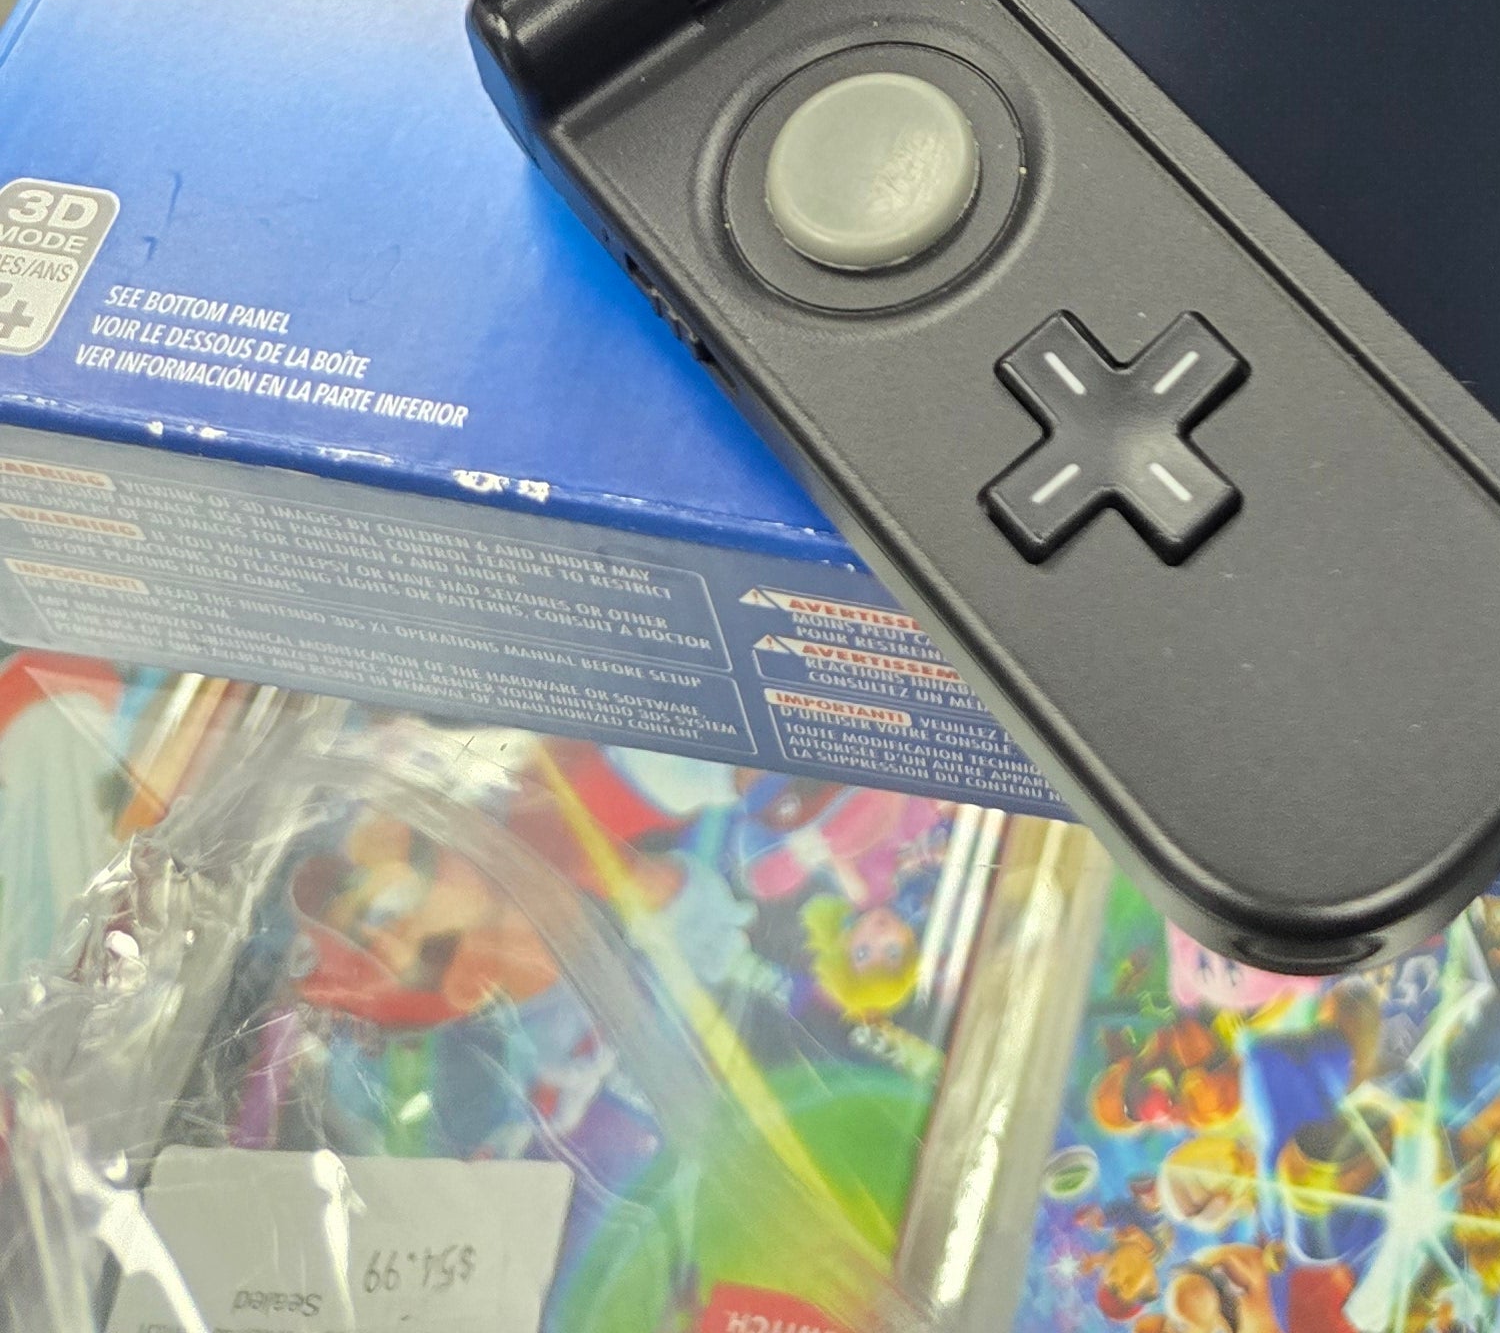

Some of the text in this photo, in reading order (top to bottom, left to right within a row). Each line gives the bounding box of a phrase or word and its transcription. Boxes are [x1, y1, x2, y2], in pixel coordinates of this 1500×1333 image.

[7, 189, 99, 229] 3D
[0, 224, 88, 254] MODE
[0, 254, 73, 283] ES/ANS
[106, 285, 294, 332] SEE BOTTOM PANEL
[90, 314, 372, 377] VOIR LE DESSOUS DE LA BOÎTE
[74, 344, 470, 426] VER INFORMACIÓN EN LA PARTE INFERIOR
[272, 506, 342, 528] IMAGES
[346, 519, 370, 533] BY
[378, 524, 470, 550] CHILDREN
[494, 545, 534, 561] AND
[542, 553, 604, 573] UNDER
[612, 565, 650, 581] MAY
[290, 523, 670, 598] PARENTAL CONTROL FEATURE TO RESTRICT
[296, 537, 448, 573] CHILDREN AND
[270, 550, 350, 573] EPILEPSY
[386, 569, 435, 588] HAVE
[440, 579, 480, 595] HAD
[484, 587, 570, 611] SEIZURES
[574, 602, 600, 616] OR
[606, 608, 666, 627] OTHER
[336, 576, 710, 648] LIGHTS OR CONSULT A DOCTOR
[792, 613, 854, 632] MOINS
[862, 625, 904, 640] PEUT
[394, 626, 498, 652] OPERATIONS
[504, 644, 574, 665] MANUAL
[580, 657, 644, 676] BEFORE
[650, 669, 702, 686] SETUP
[796, 628, 846, 644] POUR
[856, 637, 944, 660] RESTREIN
[486, 670, 578, 695] HARDWARE
[808, 671, 940, 702] CONSULTEZ UN
[676, 714, 736, 732] SYSTEM
[782, 706, 928, 739] D'UTILISER VOTRE
[920, 717, 996, 739] VEUILLEZ
[786, 723, 962, 761] TOUTE MODIFICATION
[794, 748, 1040, 797] LA SUPPRESSION DU CONTENU
[884, 751, 980, 775] D'UN AUTRE
[233, 1289, 323, 1317] Sealed
